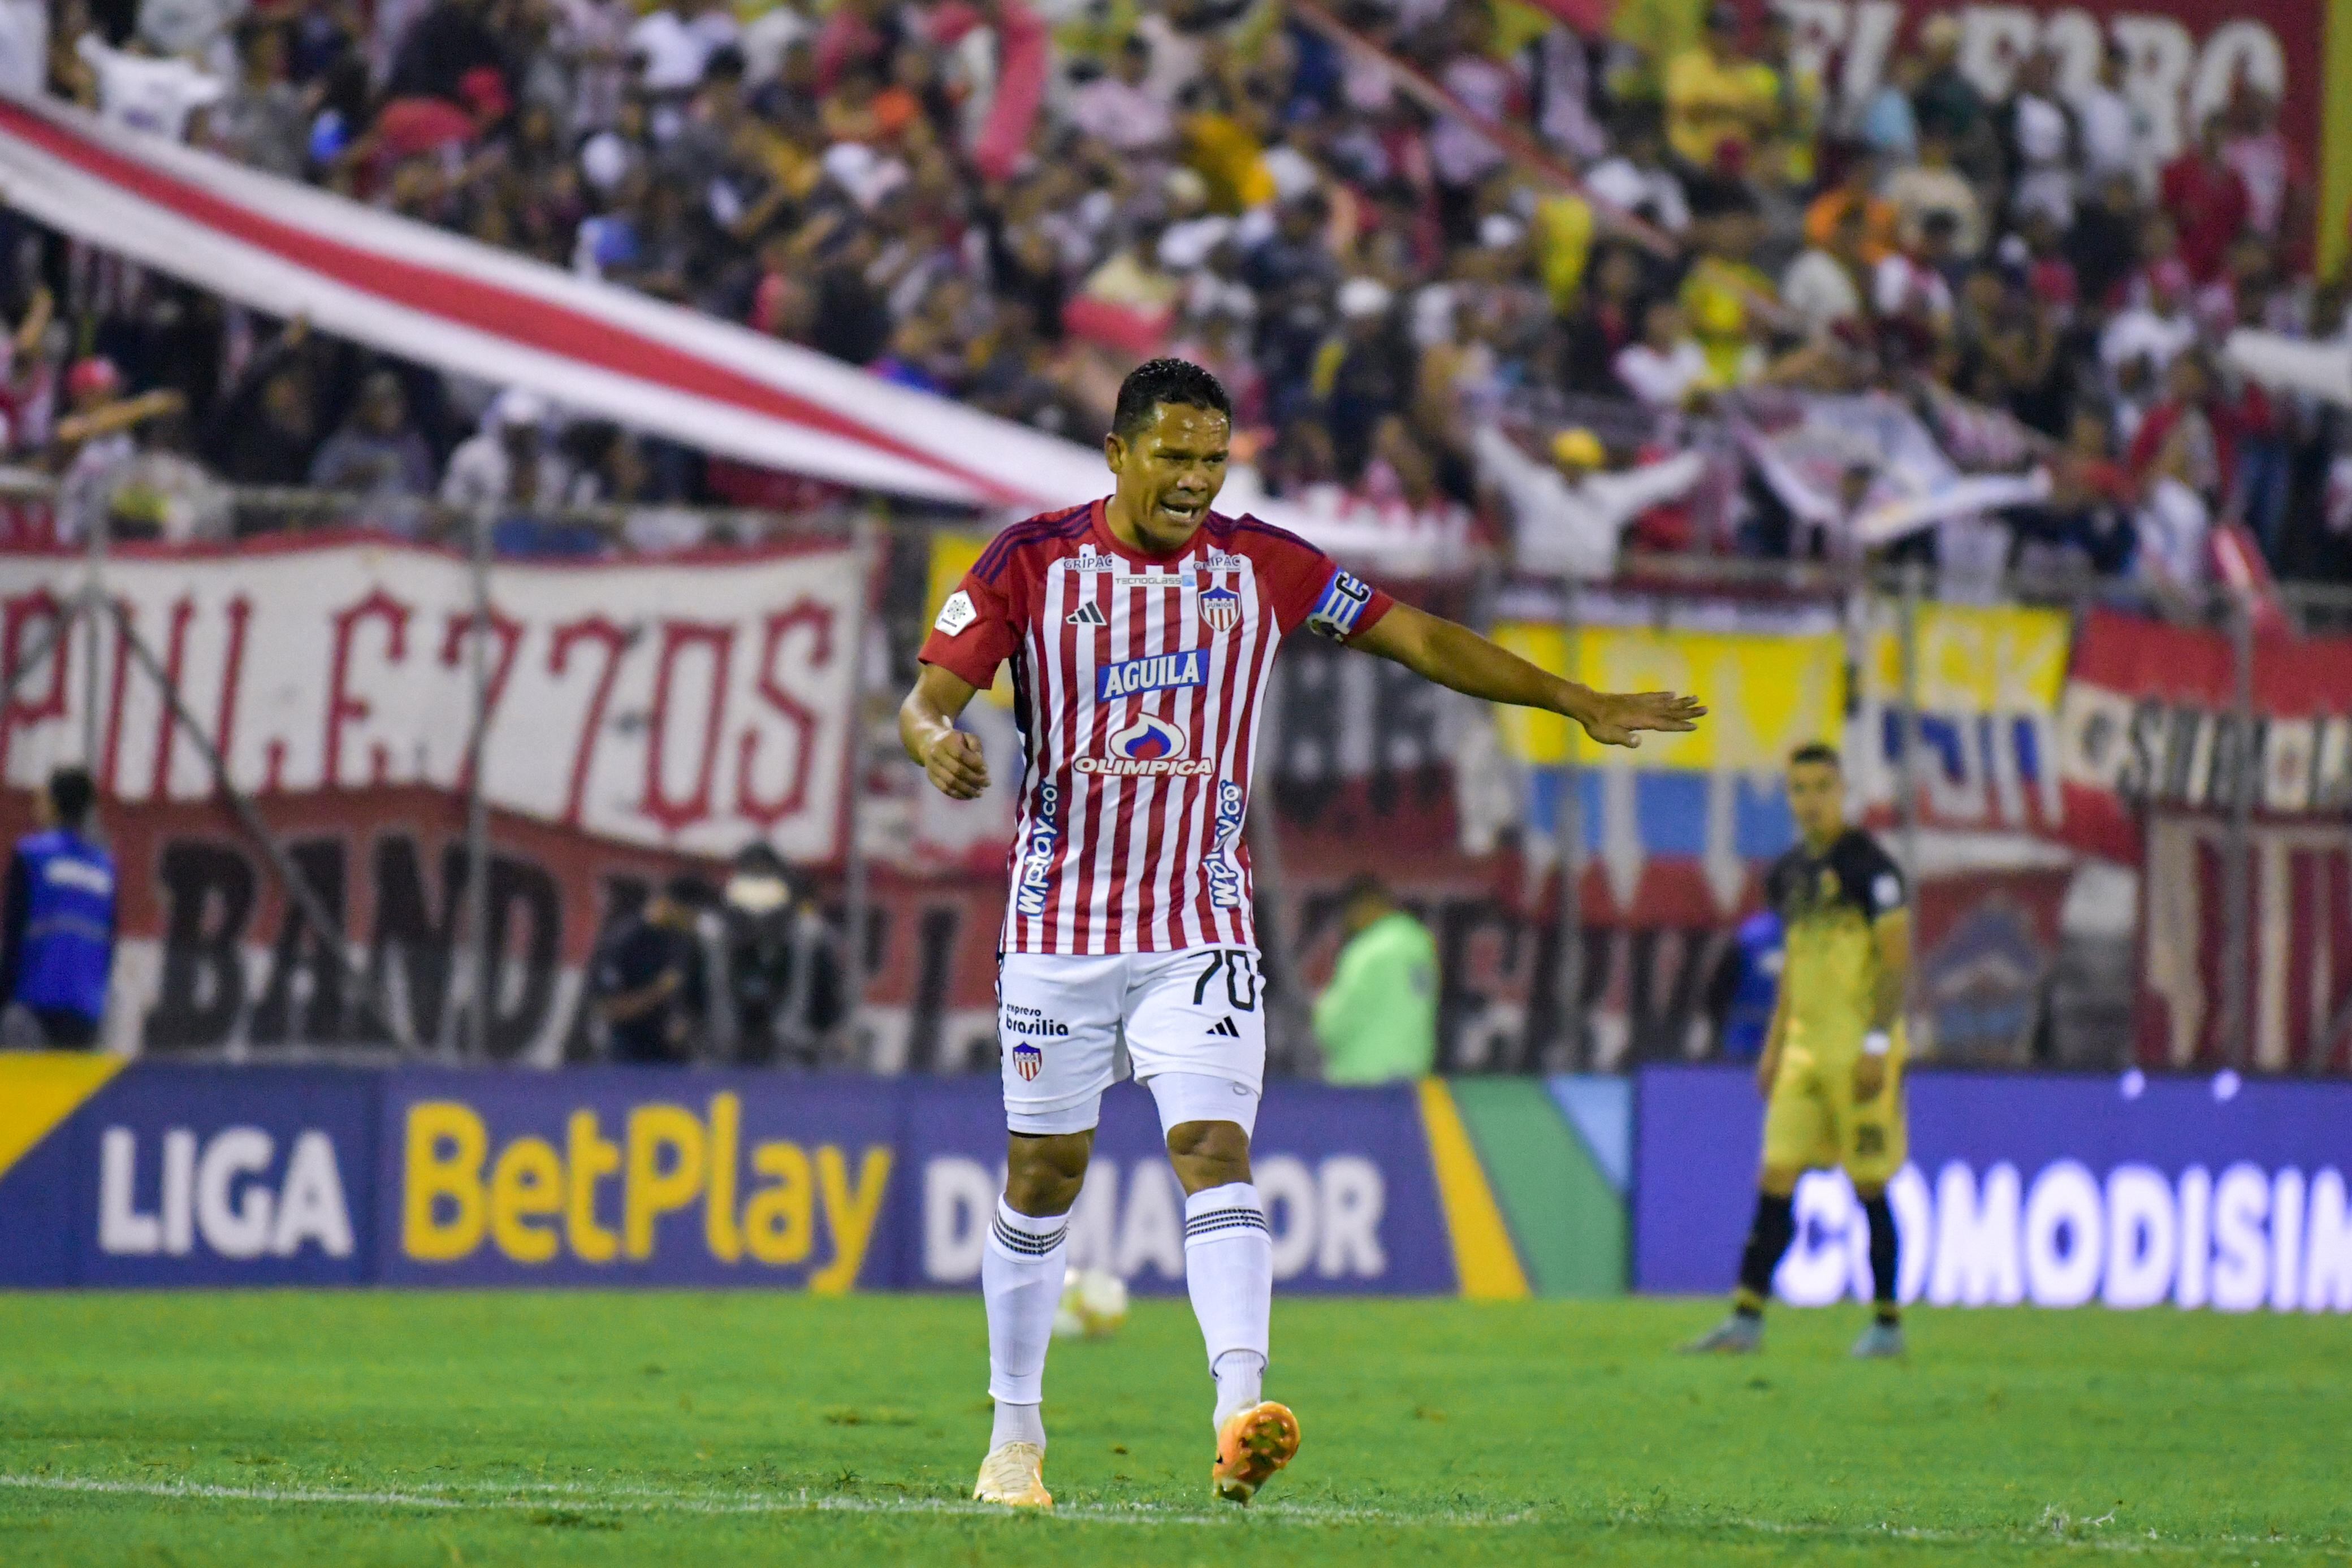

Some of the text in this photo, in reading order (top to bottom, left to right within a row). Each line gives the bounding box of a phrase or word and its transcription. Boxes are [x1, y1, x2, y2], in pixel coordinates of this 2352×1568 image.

[1103, 652, 1200, 699] AGUILA
[1075, 757, 1213, 776] OLIMPICA
[1188, 950, 1255, 1012] 70
[1006, 1003, 1041, 1016] expreso
[1006, 1013, 1069, 1036] brasilia
[100, 1127, 354, 1258] LIGA
[404, 1092, 892, 1297] BetPlay
